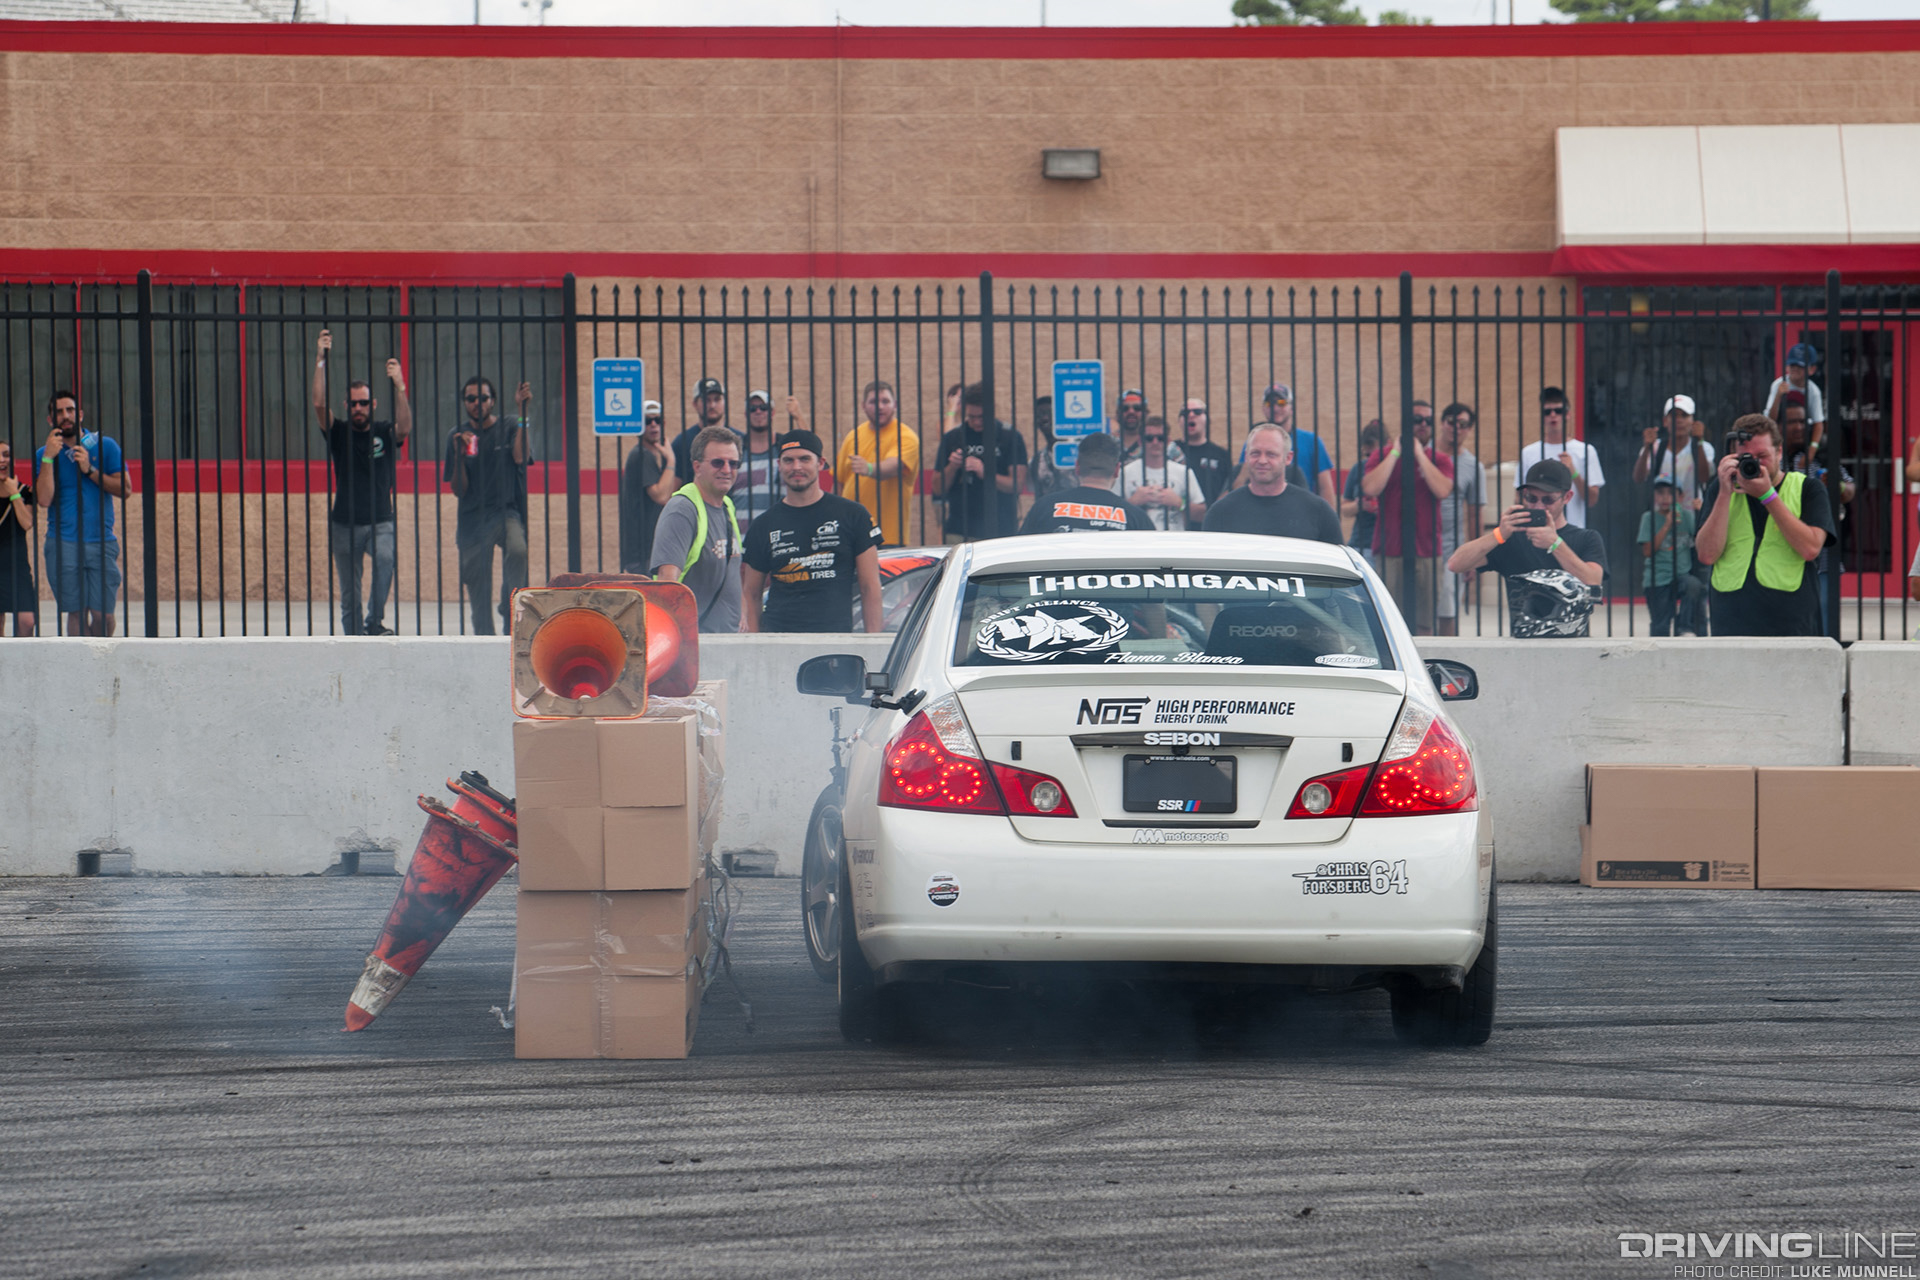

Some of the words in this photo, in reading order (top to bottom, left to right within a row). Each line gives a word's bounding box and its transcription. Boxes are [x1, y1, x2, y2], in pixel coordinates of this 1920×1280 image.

[1053, 502, 1127, 524] ZENNA
[811, 569, 837, 580] TIRES
[980, 606, 1021, 624] DRIFT
[1025, 599, 1100, 610] ALLIANCE
[1229, 624, 1298, 638] RECARO
[1104, 651, 1167, 664] Flama
[1172, 651, 1245, 665] Blanca
[1076, 697, 1151, 726] NOS
[1155, 700, 1189, 714] HIGH
[1192, 701, 1296, 716] PERFORMANCE
[1154, 714, 1193, 724] ENERGY
[1196, 714, 1229, 725] DRINK
[1143, 732, 1221, 746] SEBON
[1157, 799, 1184, 811] SSR
[1164, 832, 1229, 843] motorsports
[1369, 859, 1409, 895] 64
[1303, 880, 1371, 895] FORSBERG
